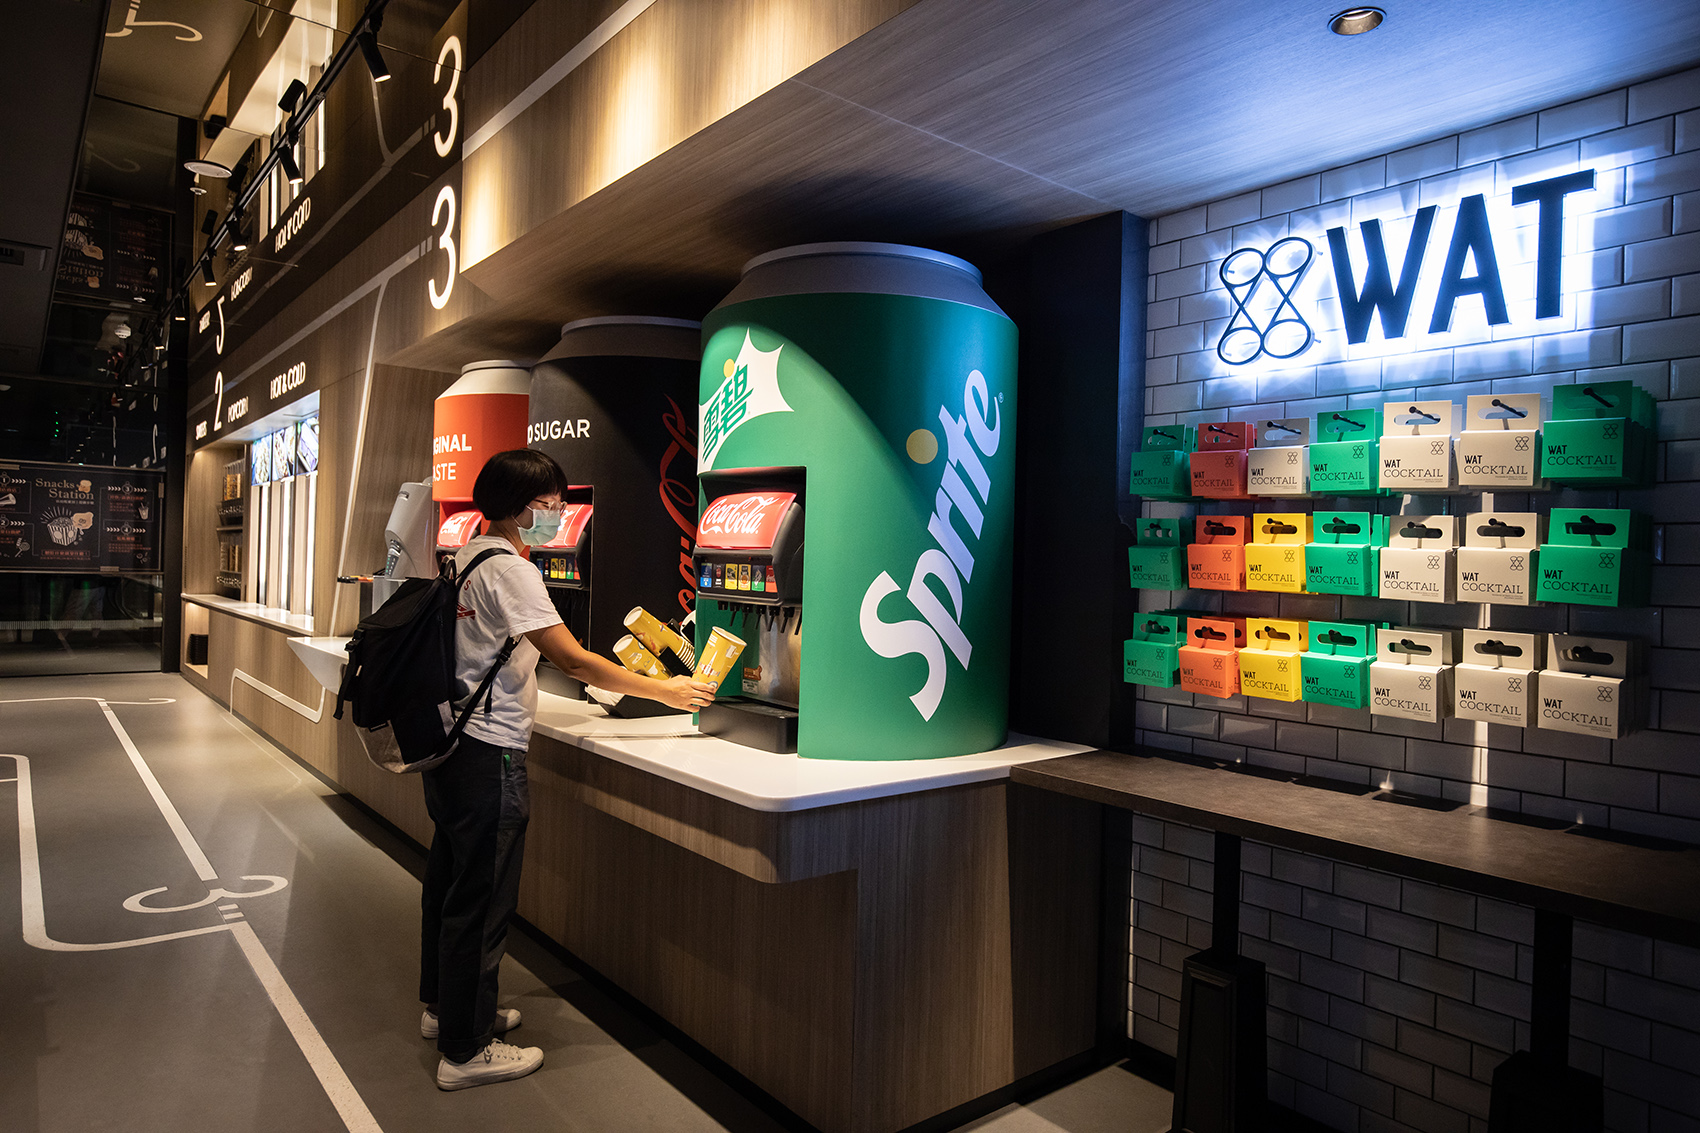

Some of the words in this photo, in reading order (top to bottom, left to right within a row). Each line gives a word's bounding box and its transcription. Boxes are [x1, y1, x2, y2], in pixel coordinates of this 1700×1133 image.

[428, 185, 457, 310] 3
[1326, 168, 1597, 344] WAT
[270, 374, 282, 400] HOT
[287, 361, 306, 391] COLD
[214, 371, 223, 431] 2
[702, 363, 754, 464] 雪碧
[534, 419, 591, 442] SUGAR
[1548, 445, 1567, 455] WAT
[1384, 459, 1401, 468] WAT
[1464, 455, 1483, 464] WAT
[1547, 455, 1616, 466] COCKTAIL
[433, 462, 456, 482] ASTE
[1251, 468, 1264, 476] WAT
[1314, 463, 1328, 472] WAT
[1464, 465, 1528, 475] COCKTAIL
[1133, 470, 1144, 478] WAT
[1313, 472, 1364, 481] COCKTAIL
[1384, 468, 1443, 478] COCKTAIL
[35, 478, 75, 489] Snacks
[1133, 477, 1169, 486] COCKTAIL
[1192, 479, 1234, 488] COCKTAIL
[1250, 476, 1297, 485] COCKTAIL
[49, 488, 94, 500] Station
[700, 496, 780, 535] Coca-Cola
[859, 369, 1001, 722] Sprite
[1191, 564, 1202, 572] WAT
[1249, 564, 1262, 573] WAT
[1309, 565, 1322, 574] WAT
[1132, 572, 1170, 582] COCKTAIL
[1191, 572, 1231, 582] COCKTAIL
[1249, 573, 1295, 582] COCKTAIL
[1309, 575, 1359, 585] COCKTAIL
[1384, 571, 1400, 580] WAT
[1462, 572, 1479, 581] WAT
[1544, 570, 1563, 580] WAT
[1384, 580, 1439, 592] COCKTAIL
[1462, 582, 1524, 594] COCKTAIL
[1542, 581, 1612, 594] COCKTAIL
[1126, 659, 1137, 668] WAT
[1126, 667, 1164, 679] COCKTAIL
[1182, 668, 1193, 676] WAT
[1244, 670, 1256, 679] WAT
[1182, 676, 1223, 689] COCKTAIL
[1243, 679, 1289, 692] COCKTAIL
[1305, 676, 1319, 685] WAT
[1304, 686, 1356, 699] COCKTAIL
[1374, 687, 1390, 697] WAT
[1460, 690, 1477, 700] WAT
[1374, 696, 1432, 712] COCKTAIL
[1460, 700, 1521, 716] COCKTAIL
[1544, 698, 1562, 710] WAT
[1543, 709, 1612, 726] COCKTAIL
